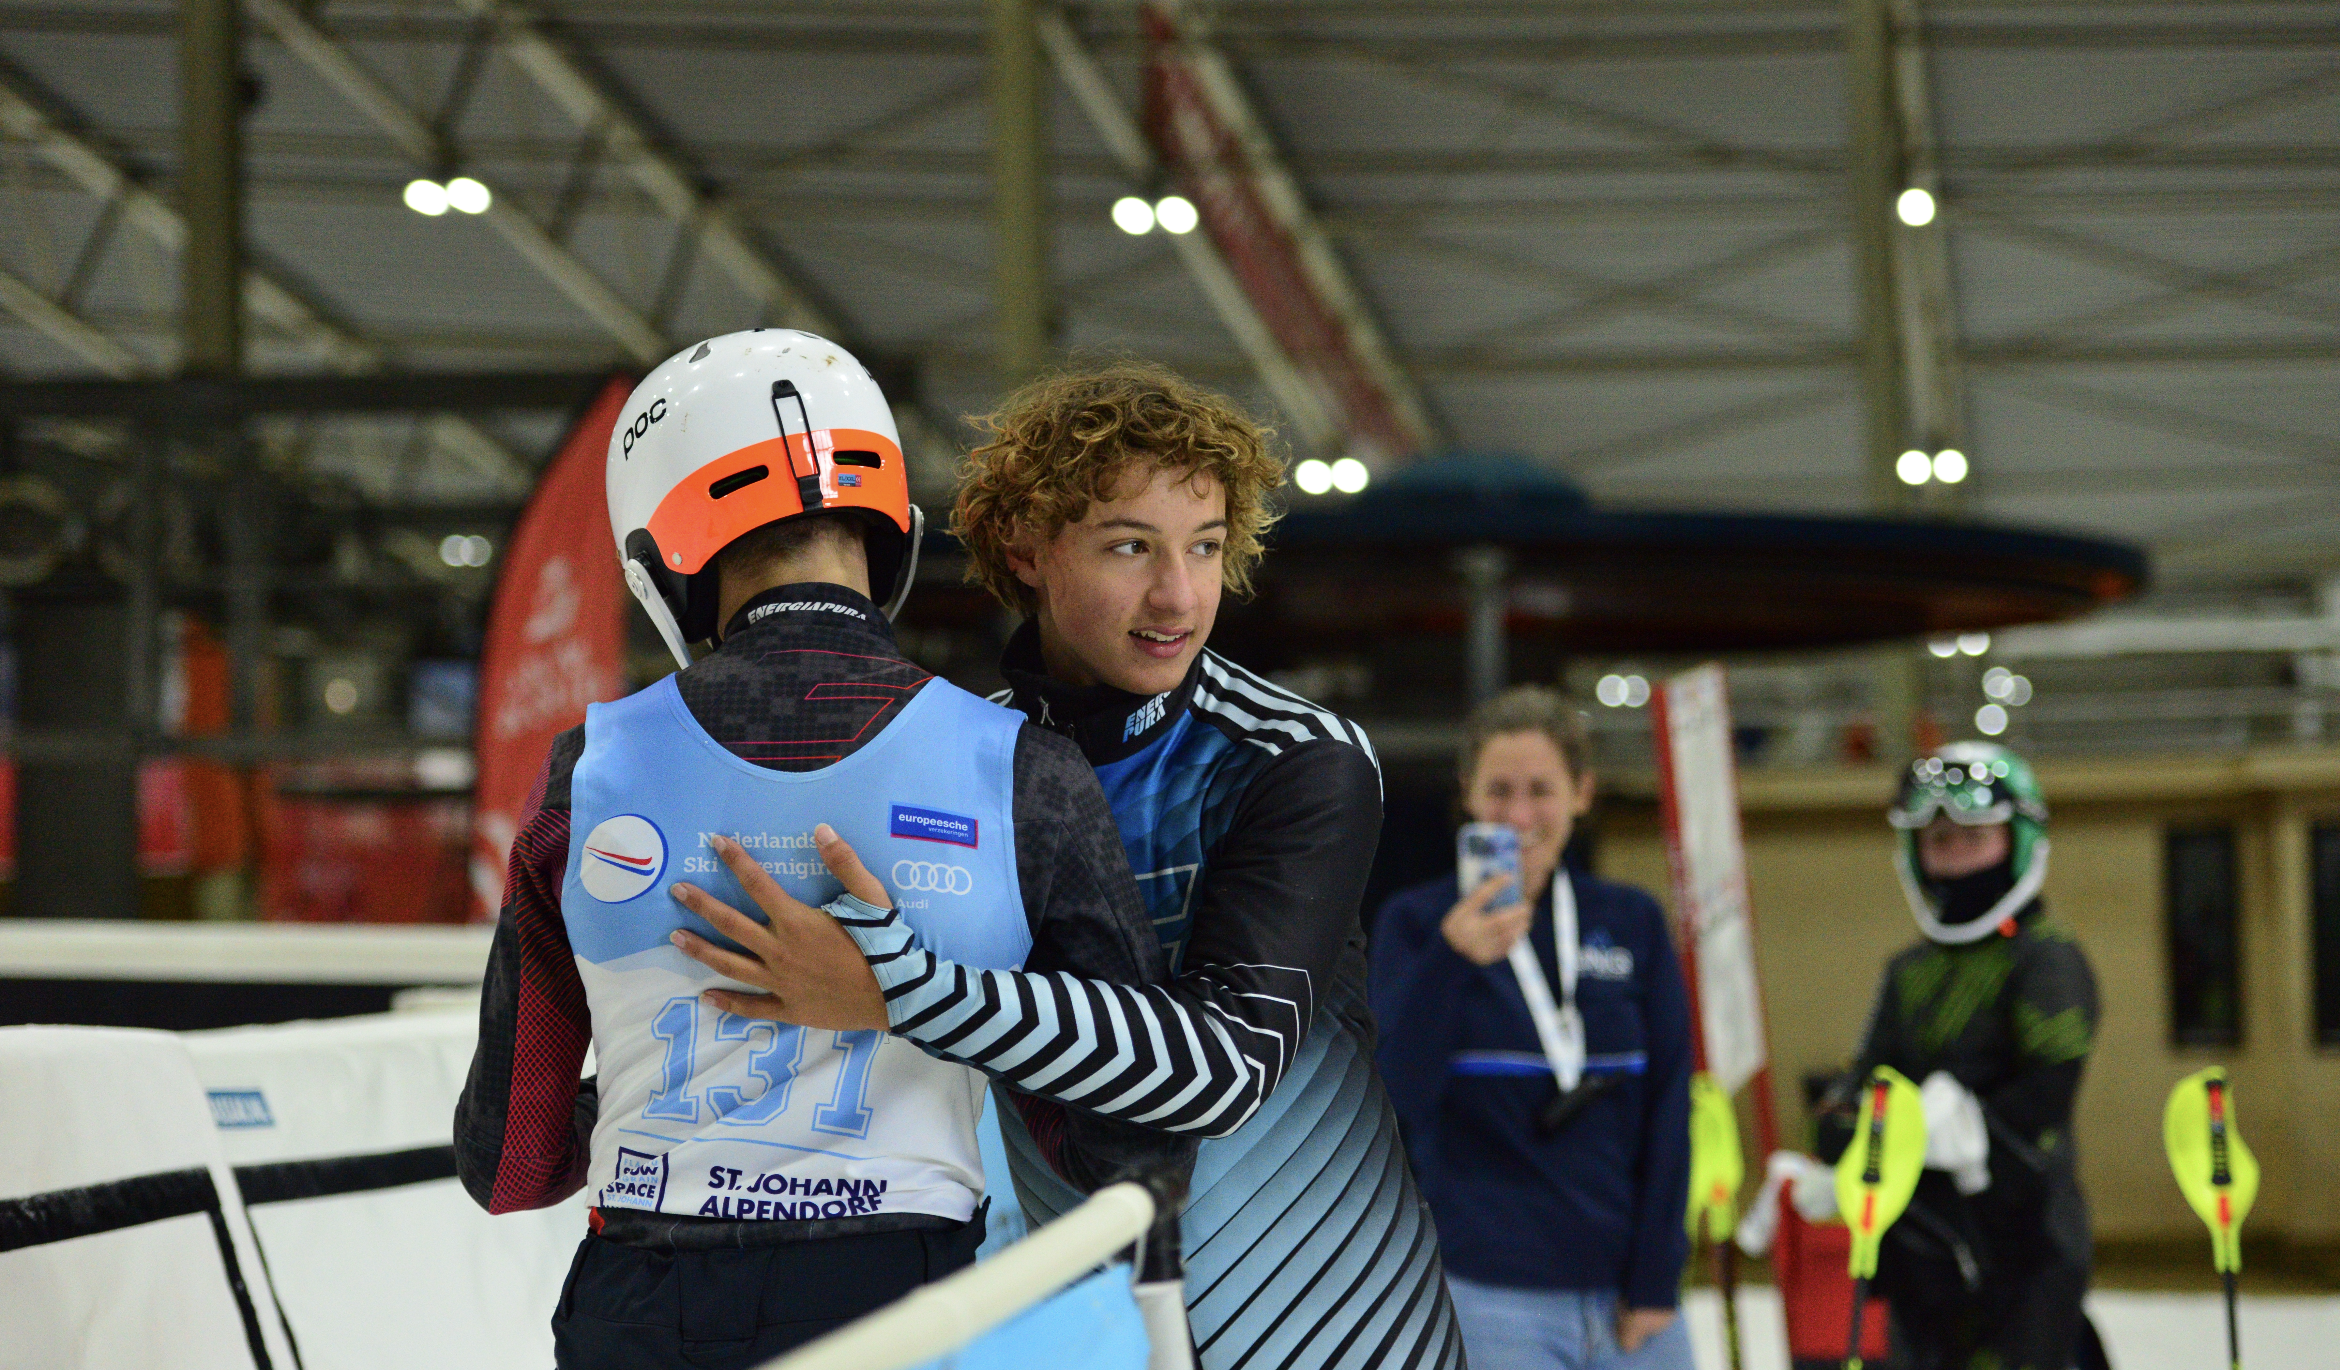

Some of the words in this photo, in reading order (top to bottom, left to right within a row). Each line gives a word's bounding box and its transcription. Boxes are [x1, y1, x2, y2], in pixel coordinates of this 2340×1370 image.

[747, 601, 867, 625] ENERGIAPURA
[1125, 691, 1171, 729] ENER
[1122, 704, 1166, 744] PURA
[898, 813, 969, 832] europeesche
[684, 856, 719, 873] Ski
[896, 898, 929, 910] Audi
[642, 996, 887, 1141] 131
[606, 1182, 657, 1199] SPACE
[708, 1165, 743, 1191] ST.
[746, 1173, 888, 1198] JOHANN
[698, 1195, 883, 1221] ALPENDORF
